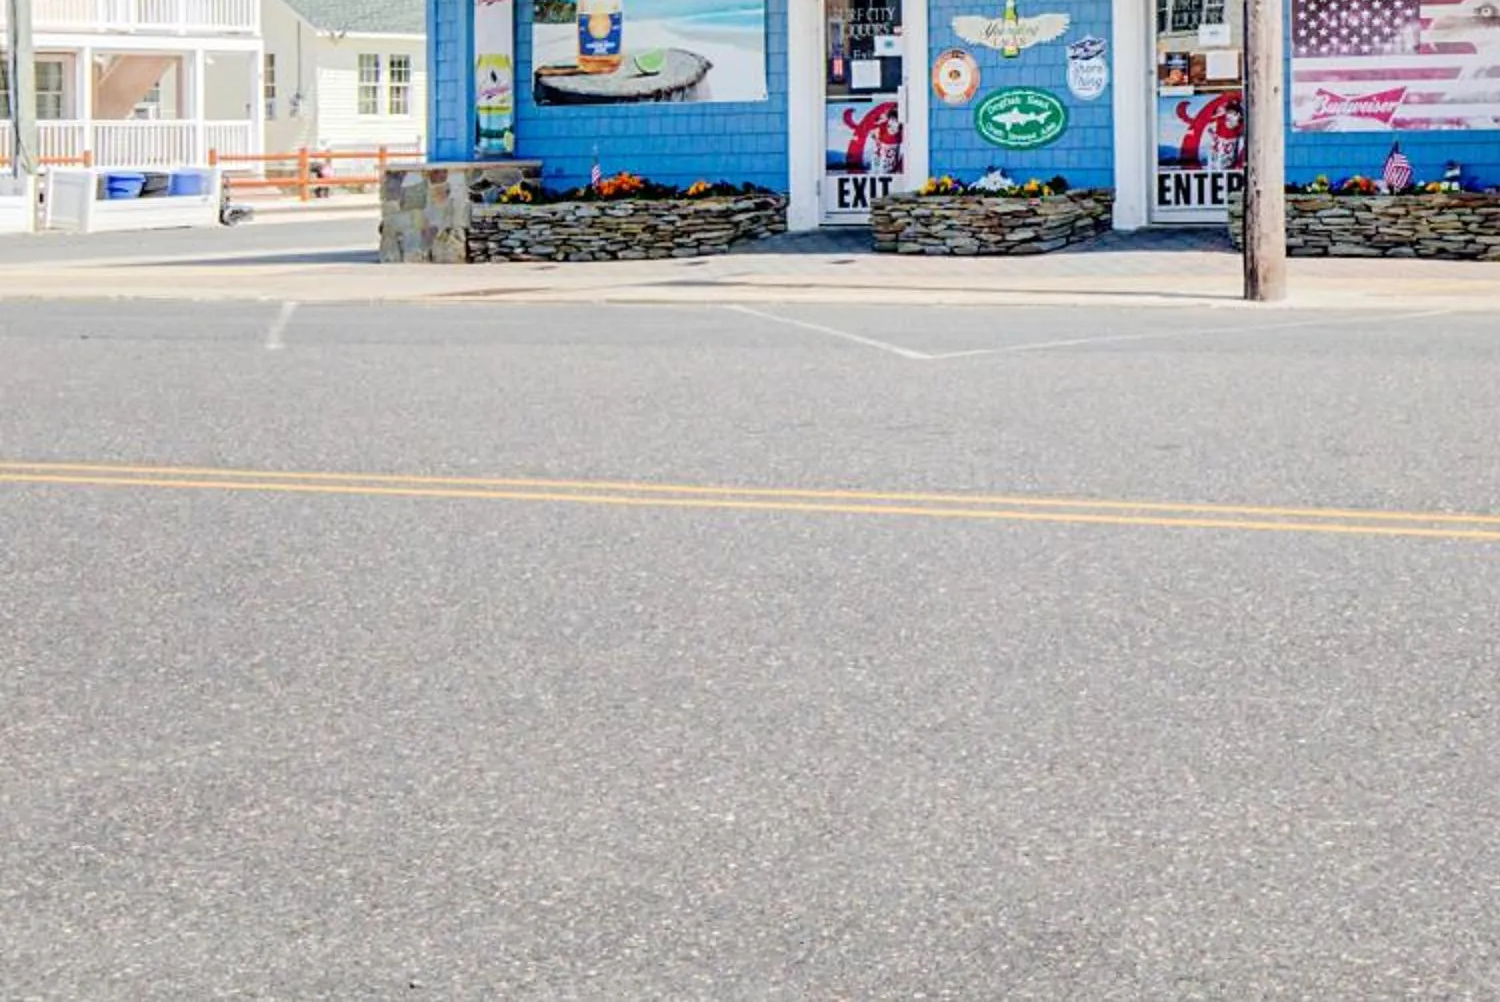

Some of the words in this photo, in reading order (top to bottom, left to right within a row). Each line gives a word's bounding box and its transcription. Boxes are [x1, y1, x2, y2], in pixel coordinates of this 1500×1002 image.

[866, 7, 896, 21] CITY
[1313, 95, 1399, 115] Budweiser
[837, 177, 893, 208] EXIT
